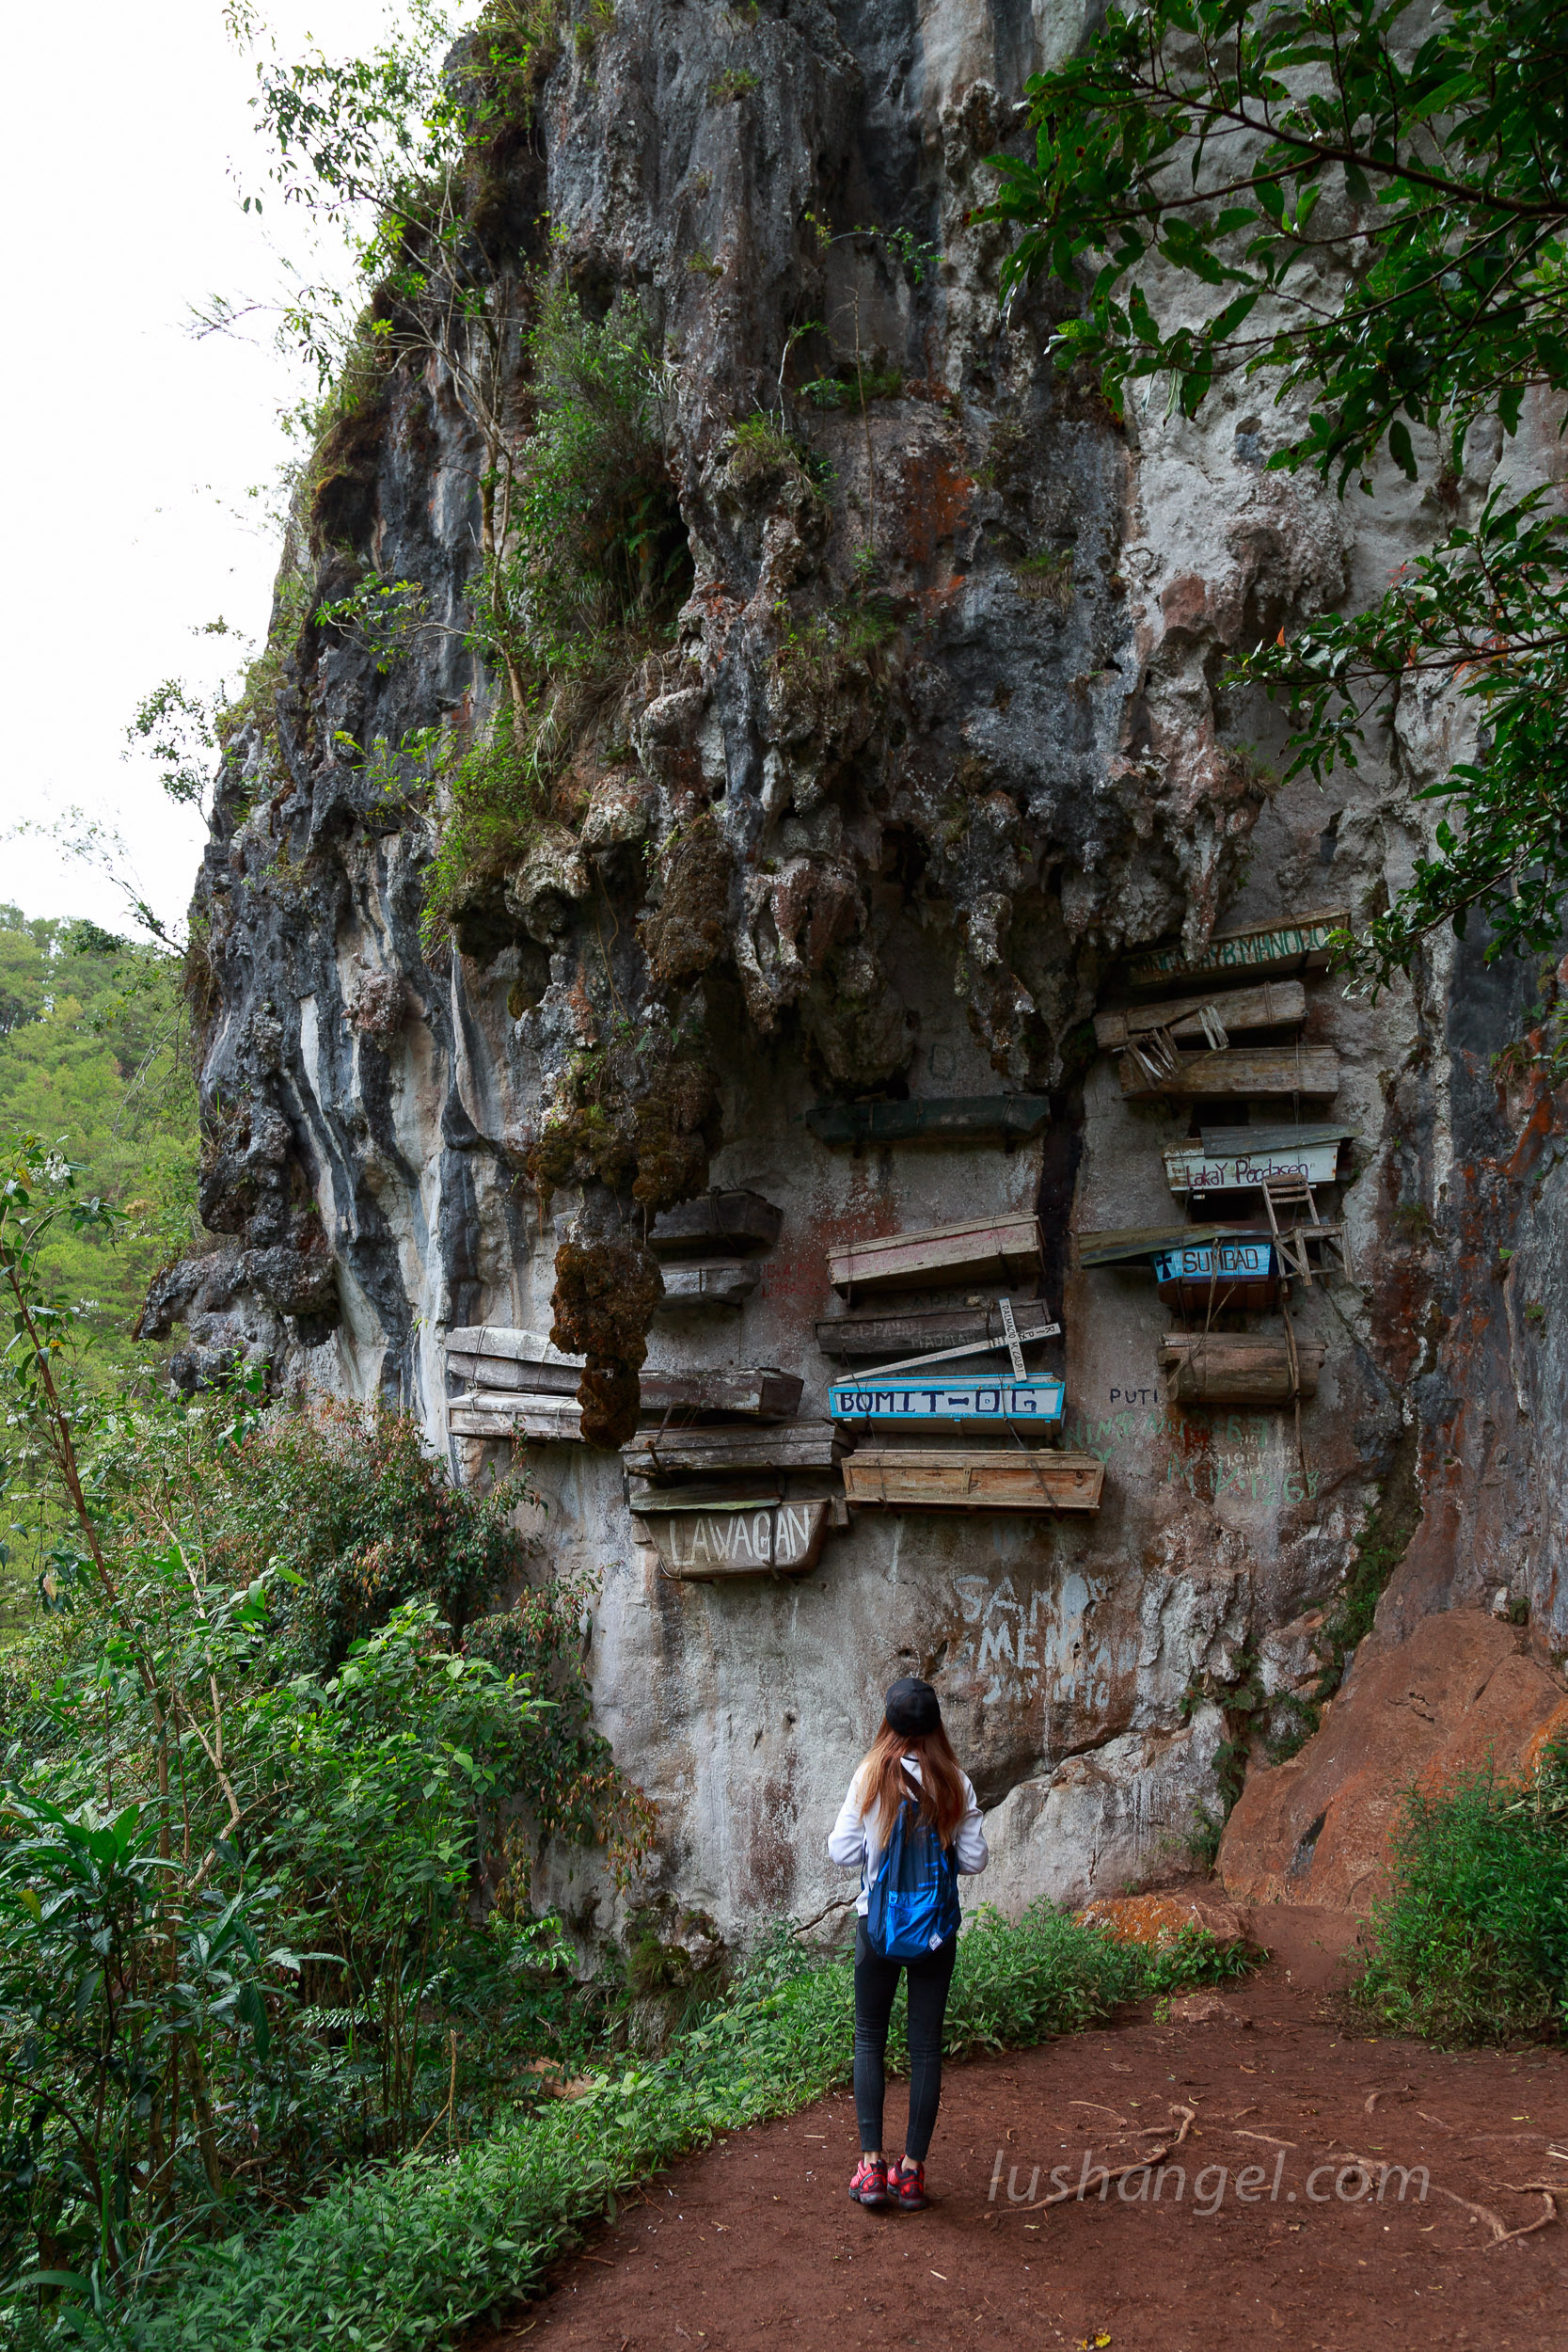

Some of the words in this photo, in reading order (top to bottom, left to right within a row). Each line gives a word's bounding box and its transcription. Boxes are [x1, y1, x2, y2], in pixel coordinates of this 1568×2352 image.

[1182, 1248, 1259, 1274] SUMBAD
[840, 1390, 1037, 1414] BOMIT-OG
[1109, 1388, 1158, 1405] PUTI
[669, 1504, 811, 1566] LAWAGAN
